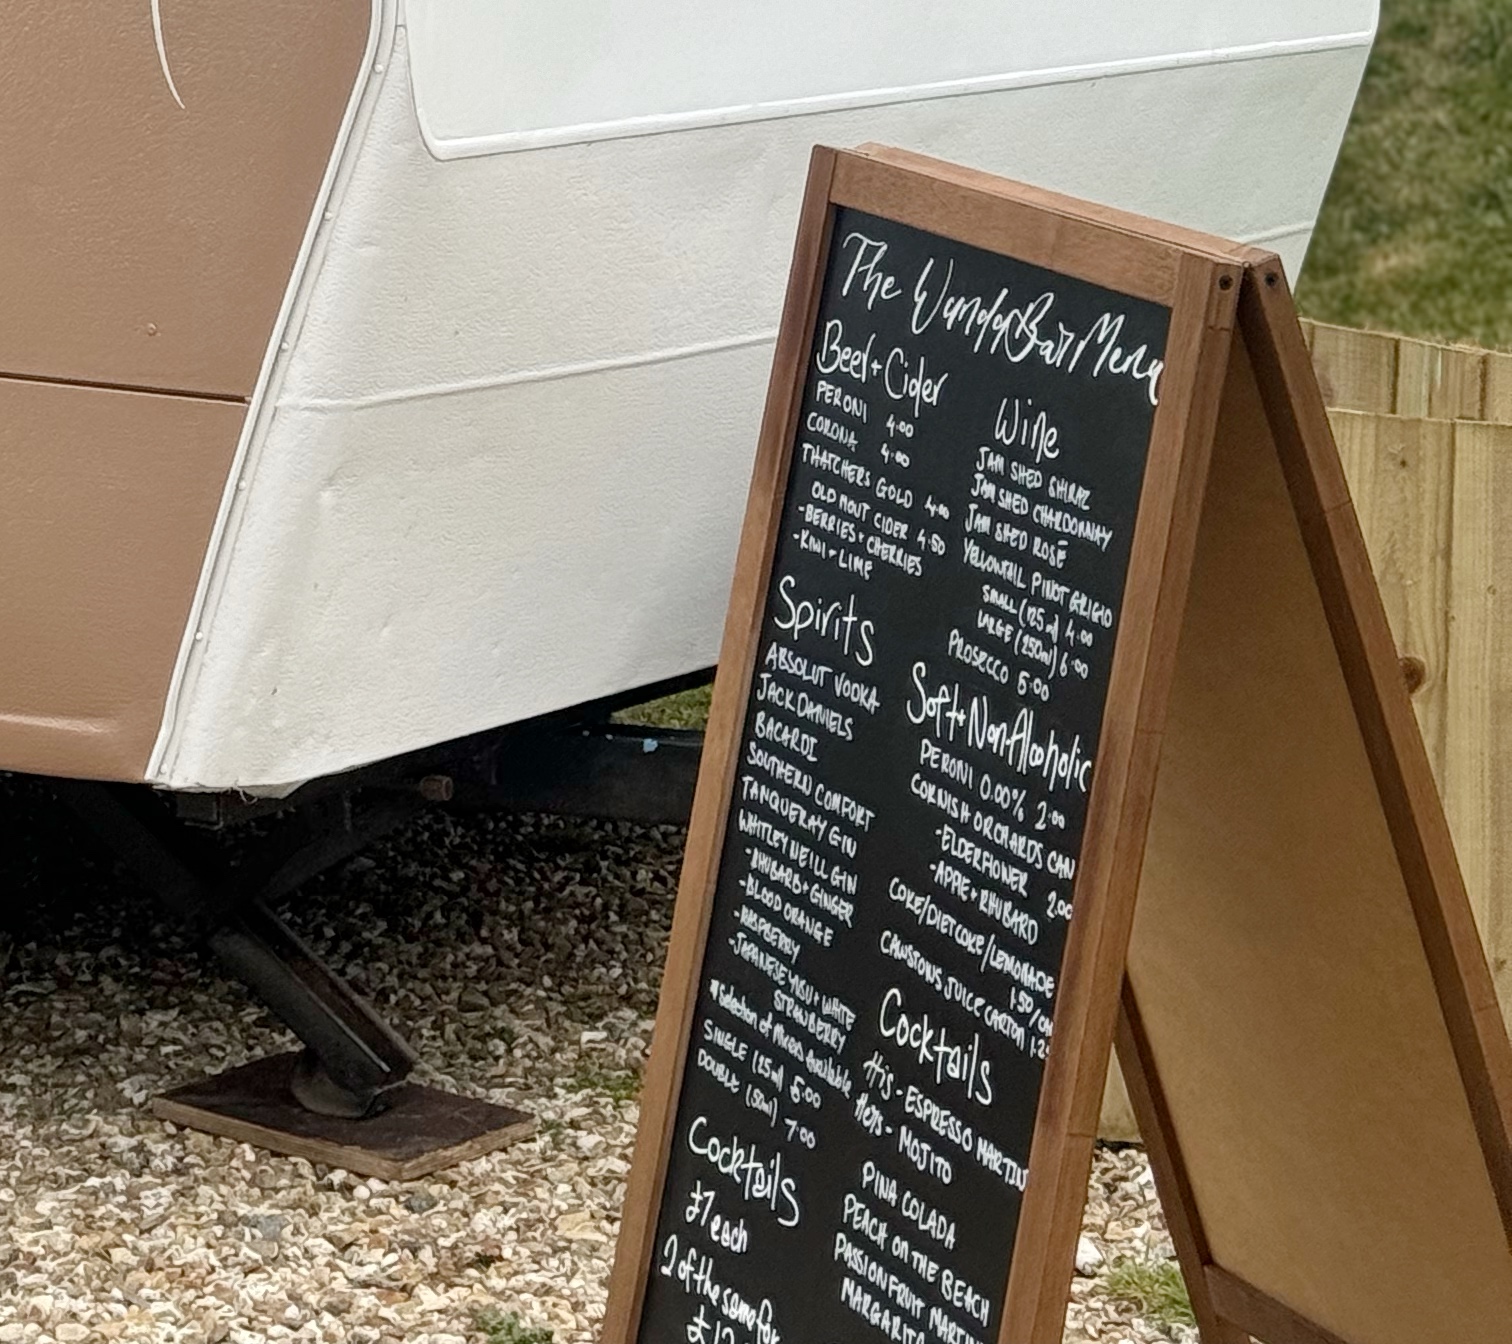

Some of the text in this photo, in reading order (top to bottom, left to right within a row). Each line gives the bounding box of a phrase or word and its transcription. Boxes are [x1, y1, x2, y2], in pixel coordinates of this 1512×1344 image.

[843, 232, 902, 310] The
[1068, 313, 1164, 405] Menu
[816, 319, 876, 383] Beer
[884, 348, 949, 418] Cider
[806, 412, 858, 452] CORONA
[816, 380, 868, 424] PERONI
[994, 398, 1059, 463] Wine
[802, 443, 871, 487] THATCHERS
[876, 477, 913, 508] GOLD
[971, 473, 996, 503] JAM
[998, 488, 1029, 515] SHED
[976, 447, 1090, 510] JAM SHED SHIRAZ
[811, 481, 837, 503] OLD
[839, 494, 871, 522] MOUT
[873, 513, 909, 540] CIDER
[965, 503, 991, 535] JAM
[995, 522, 1027, 550] SHED
[839, 548, 873, 580] LIME
[866, 536, 923, 577] CHERRIES
[774, 575, 874, 666] Spirits
[978, 609, 1014, 642] LARGE
[982, 585, 1017, 614] SMALL
[1031, 572, 1070, 606] PINOT
[1069, 591, 1112, 628] GRIGIO
[765, 642, 880, 714] ABSOLUT VODKA
[948, 629, 1008, 684] PROSECCO
[757, 673, 853, 741] JACK DANIELS
[906, 662, 960, 741] Soft
[755, 711, 818, 762] BACARDI
[747, 741, 875, 832] SOUTHERN COMFORT
[920, 738, 973, 790] PERONI
[979, 774, 1026, 822] 0.00%
[742, 775, 857, 858] TANQUERAY GIN
[911, 773, 1075, 880] CORNISH ORCHARDS CAN
[739, 809, 857, 895] WHITLEY NEILL GIN
[783, 902, 834, 947] ORANGE
[809, 883, 854, 928] GINGER
[881, 931, 942, 991] CAWSTONS
[944, 976, 986, 1017] JUICE
[703, 1019, 748, 1061] SINGLE
[774, 989, 846, 1054] STRAWBERRY
[822, 995, 856, 1031] WHITE
[697, 1048, 739, 1093] DOUBLE
[880, 988, 992, 1105] Cocktails
[863, 1051, 894, 1100] His
[905, 1085, 972, 1152] ESPRESSO
[854, 1092, 883, 1136] Hers
[898, 1125, 952, 1185] MOJITO
[689, 1116, 800, 1227] Cocktails
[685, 1180, 748, 1253] £7 each
[862, 1161, 956, 1250] PINA COLADA
[660, 1234, 678, 1276] 2
[693, 1255, 720, 1306] the
[843, 1193, 888, 1251] PEACH
[911, 1250, 940, 1283] THE
[941, 1269, 990, 1328] BEACH
